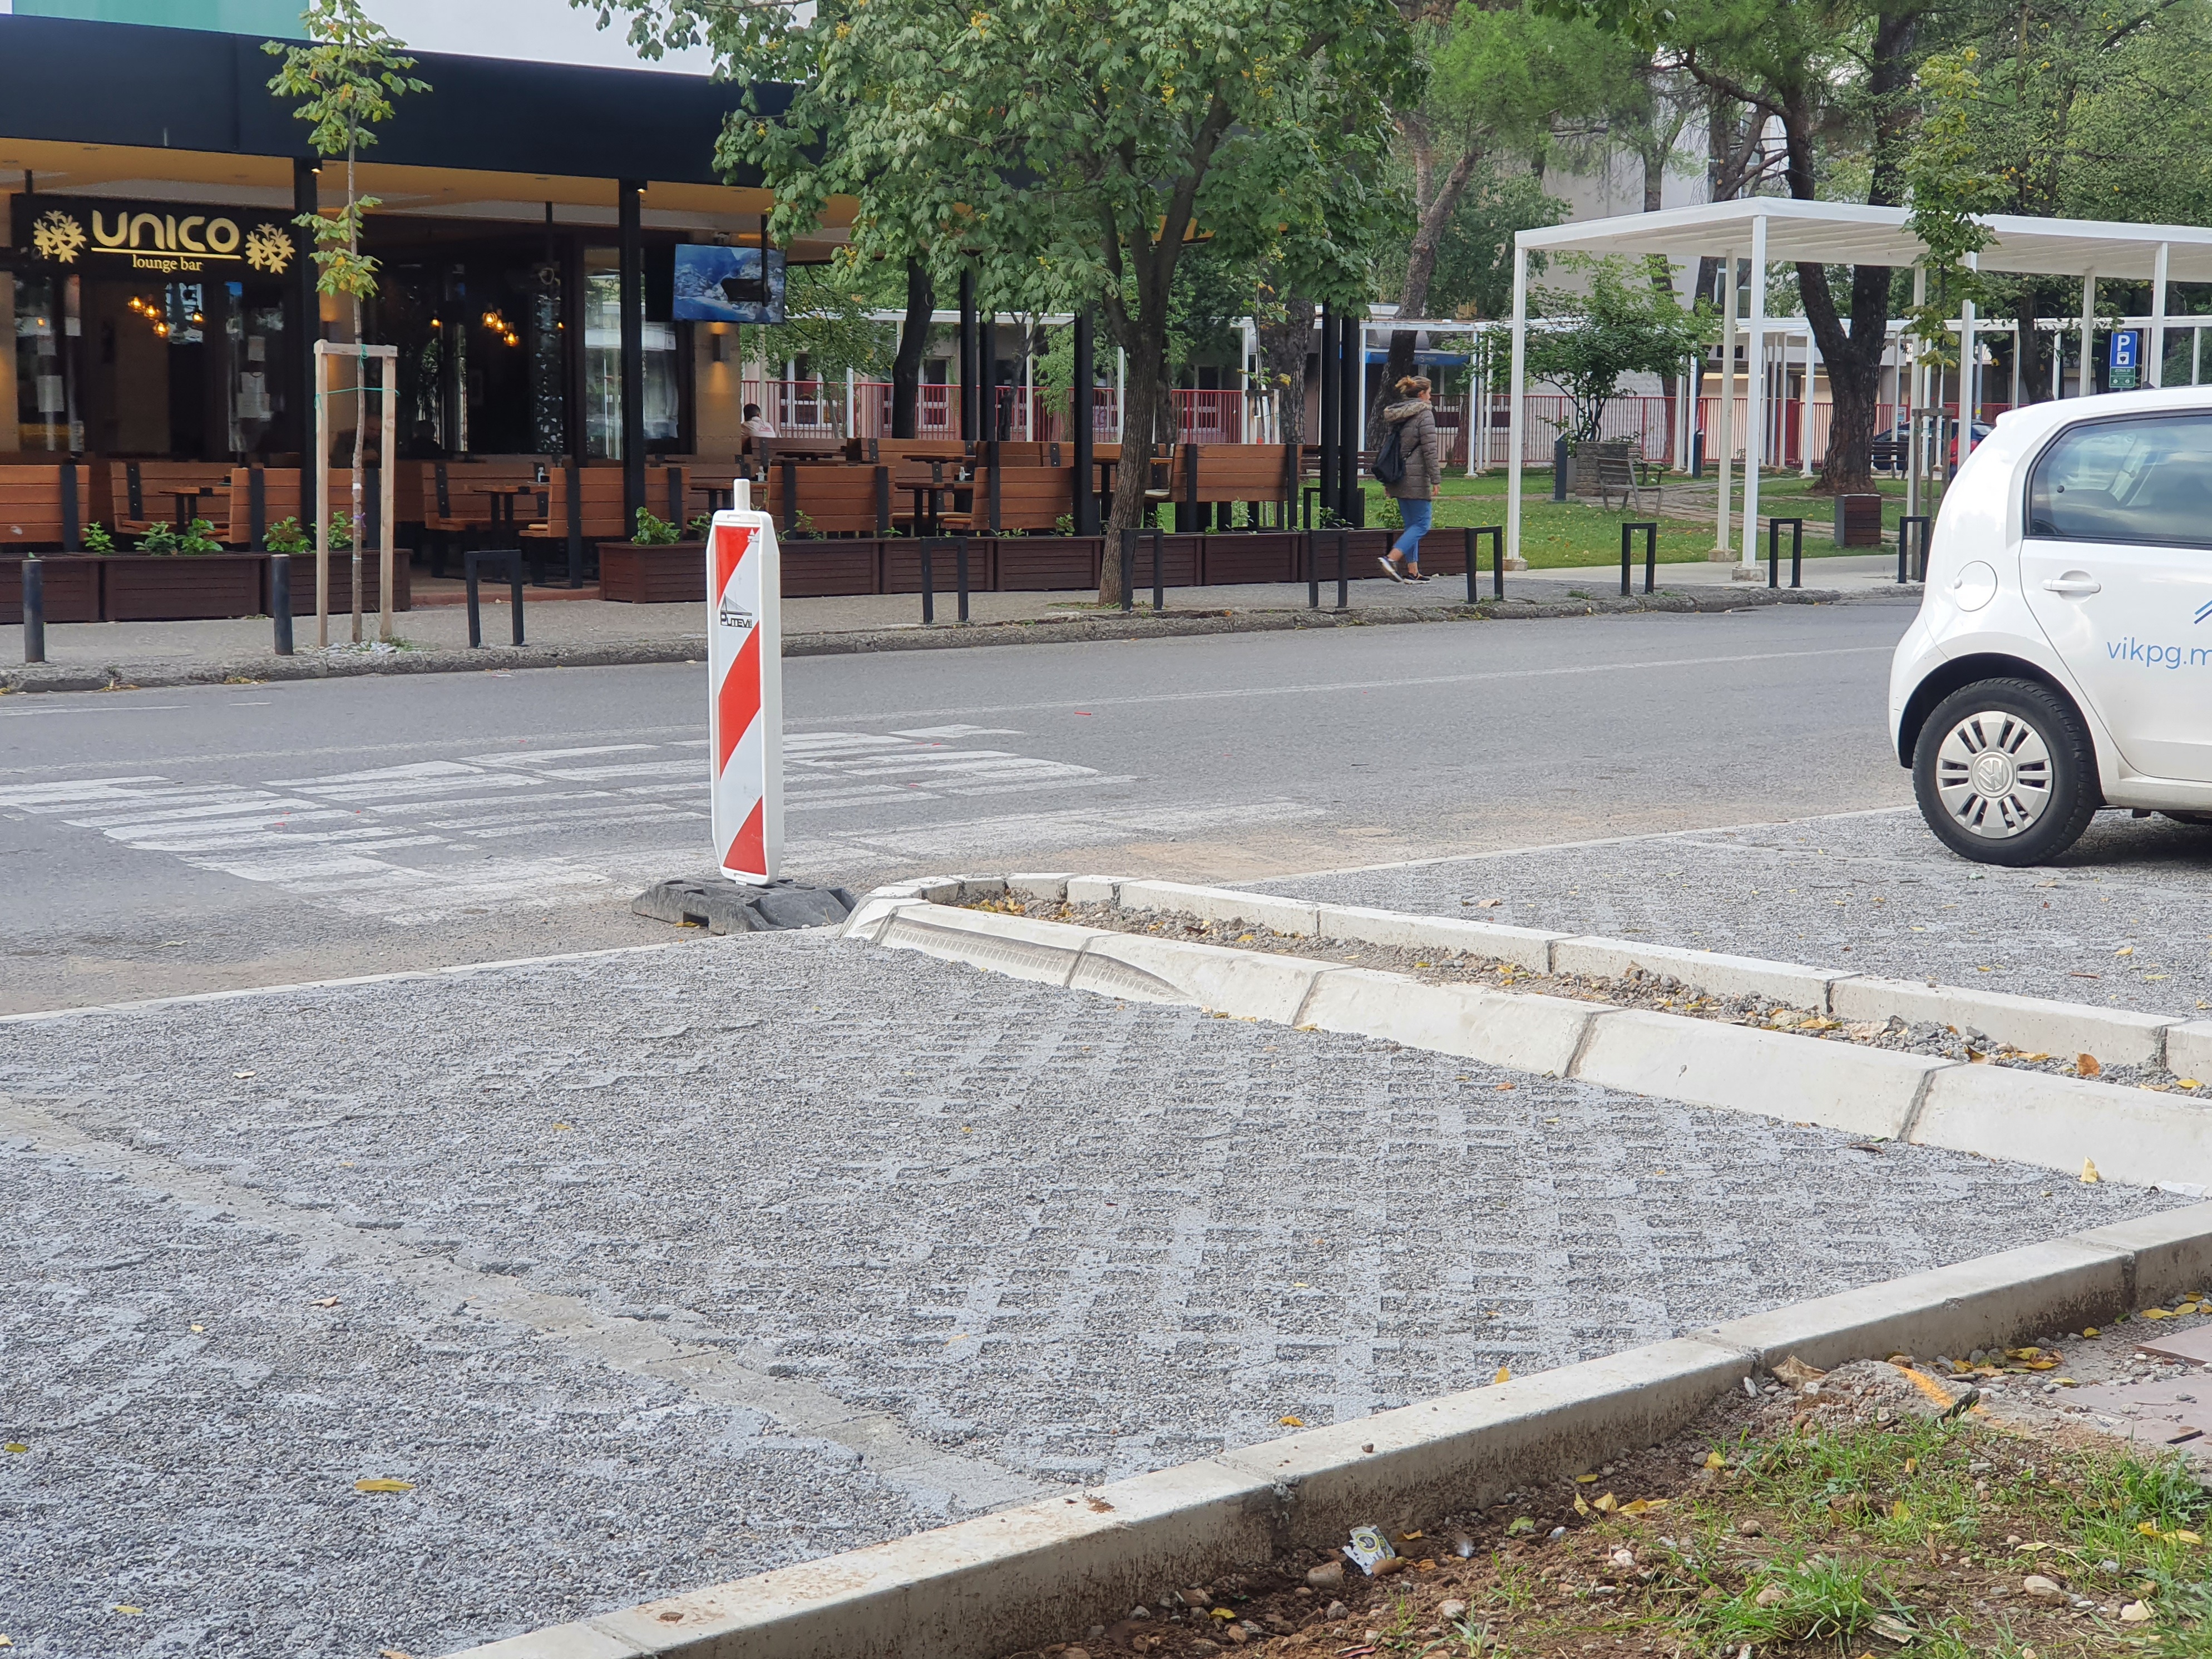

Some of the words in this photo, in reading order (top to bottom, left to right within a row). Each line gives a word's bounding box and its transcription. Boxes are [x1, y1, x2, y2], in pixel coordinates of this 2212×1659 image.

[92, 209, 240, 253] UNICO
[132, 254, 177, 273] lounge
[180, 256, 203, 271] bar
[2117, 335, 2130, 351] P
[2107, 637, 2212, 669] vikpg.m
